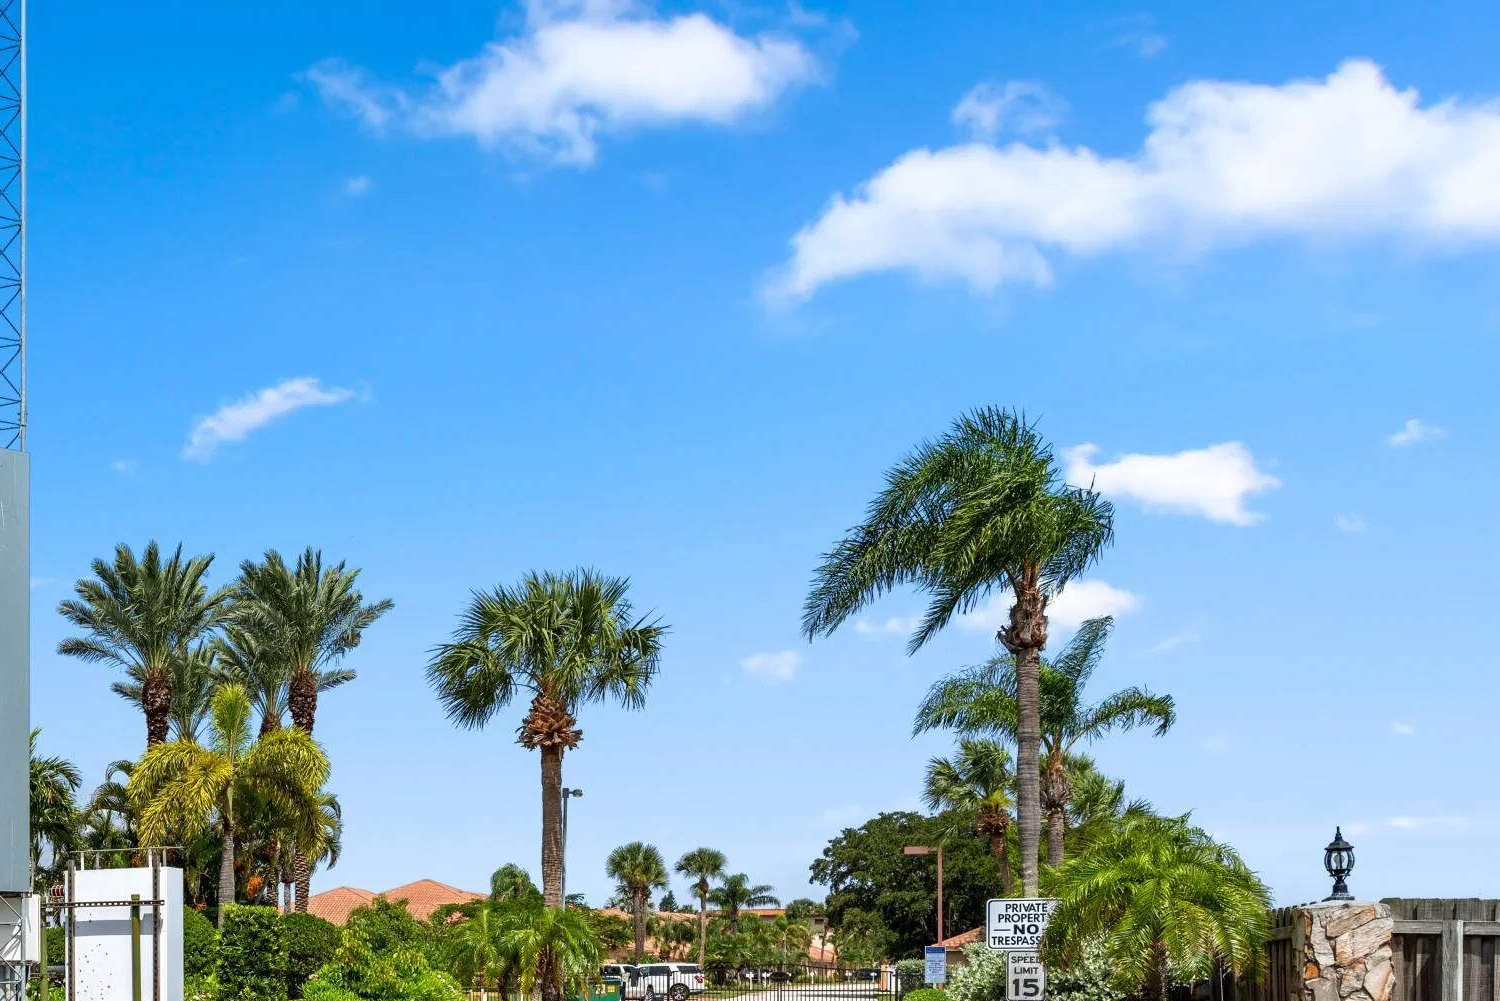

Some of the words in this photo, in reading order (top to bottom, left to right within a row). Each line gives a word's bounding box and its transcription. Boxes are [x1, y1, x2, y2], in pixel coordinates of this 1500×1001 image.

[1005, 903, 1048, 913] PRIVATE
[998, 913, 1051, 923] PROPERT
[1013, 924, 1039, 935] NO
[991, 936, 1042, 946] TRESPASS
[1014, 967, 1039, 975] LIMIT
[1012, 978, 1040, 997] 15
